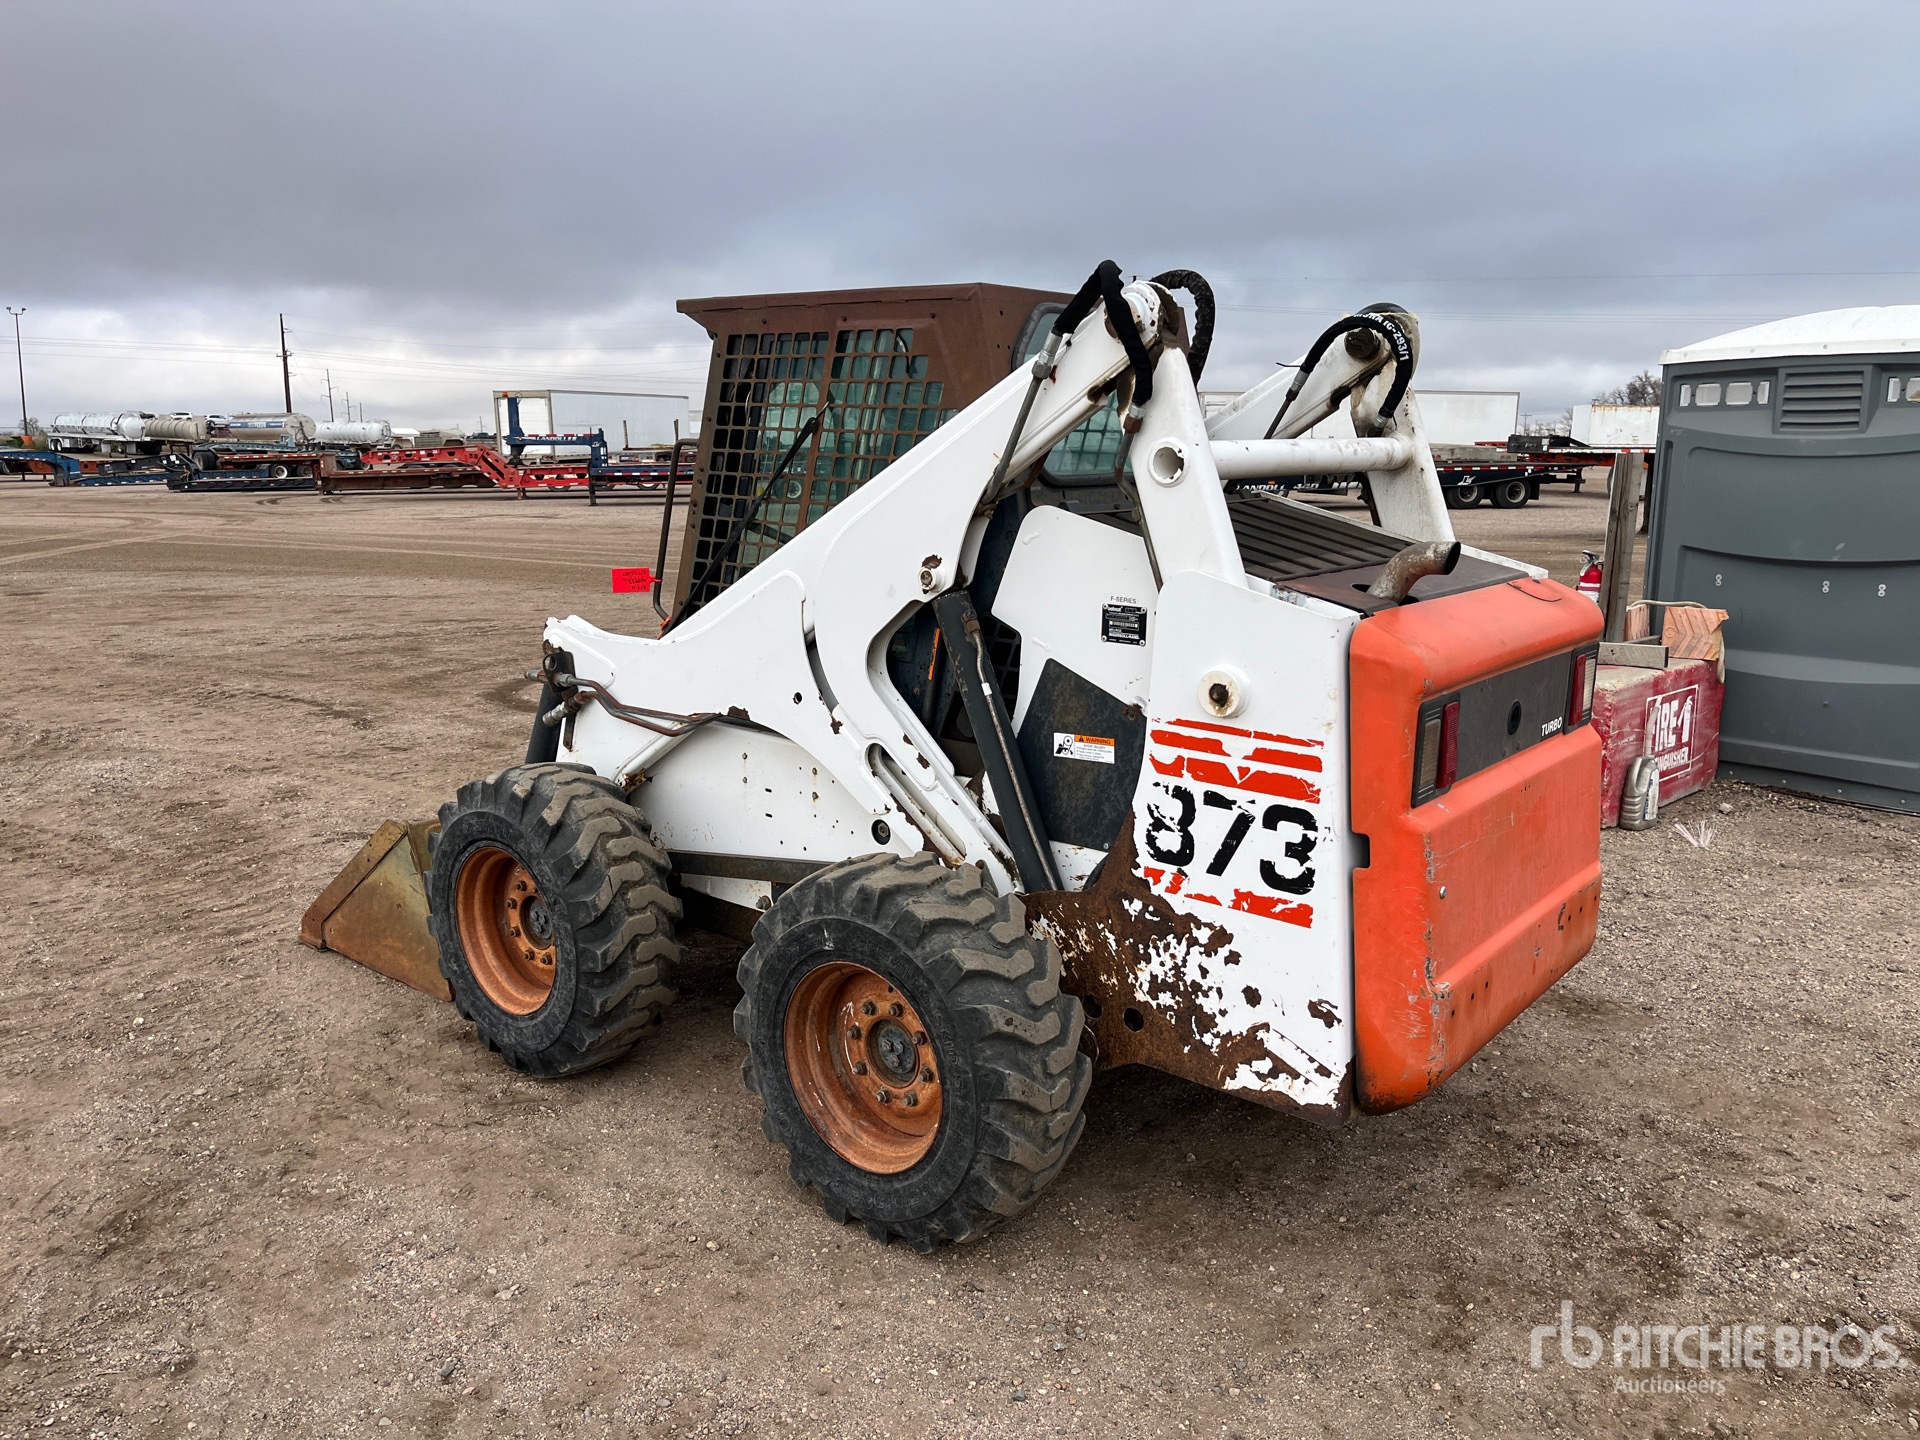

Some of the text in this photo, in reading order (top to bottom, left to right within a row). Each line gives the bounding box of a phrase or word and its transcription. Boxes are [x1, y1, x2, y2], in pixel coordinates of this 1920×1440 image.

[1110, 595, 1137, 604] F-SERIES
[1541, 716, 1563, 737] TURBO
[1086, 737, 1111, 745] WARNING
[1146, 782, 1318, 895] 873
